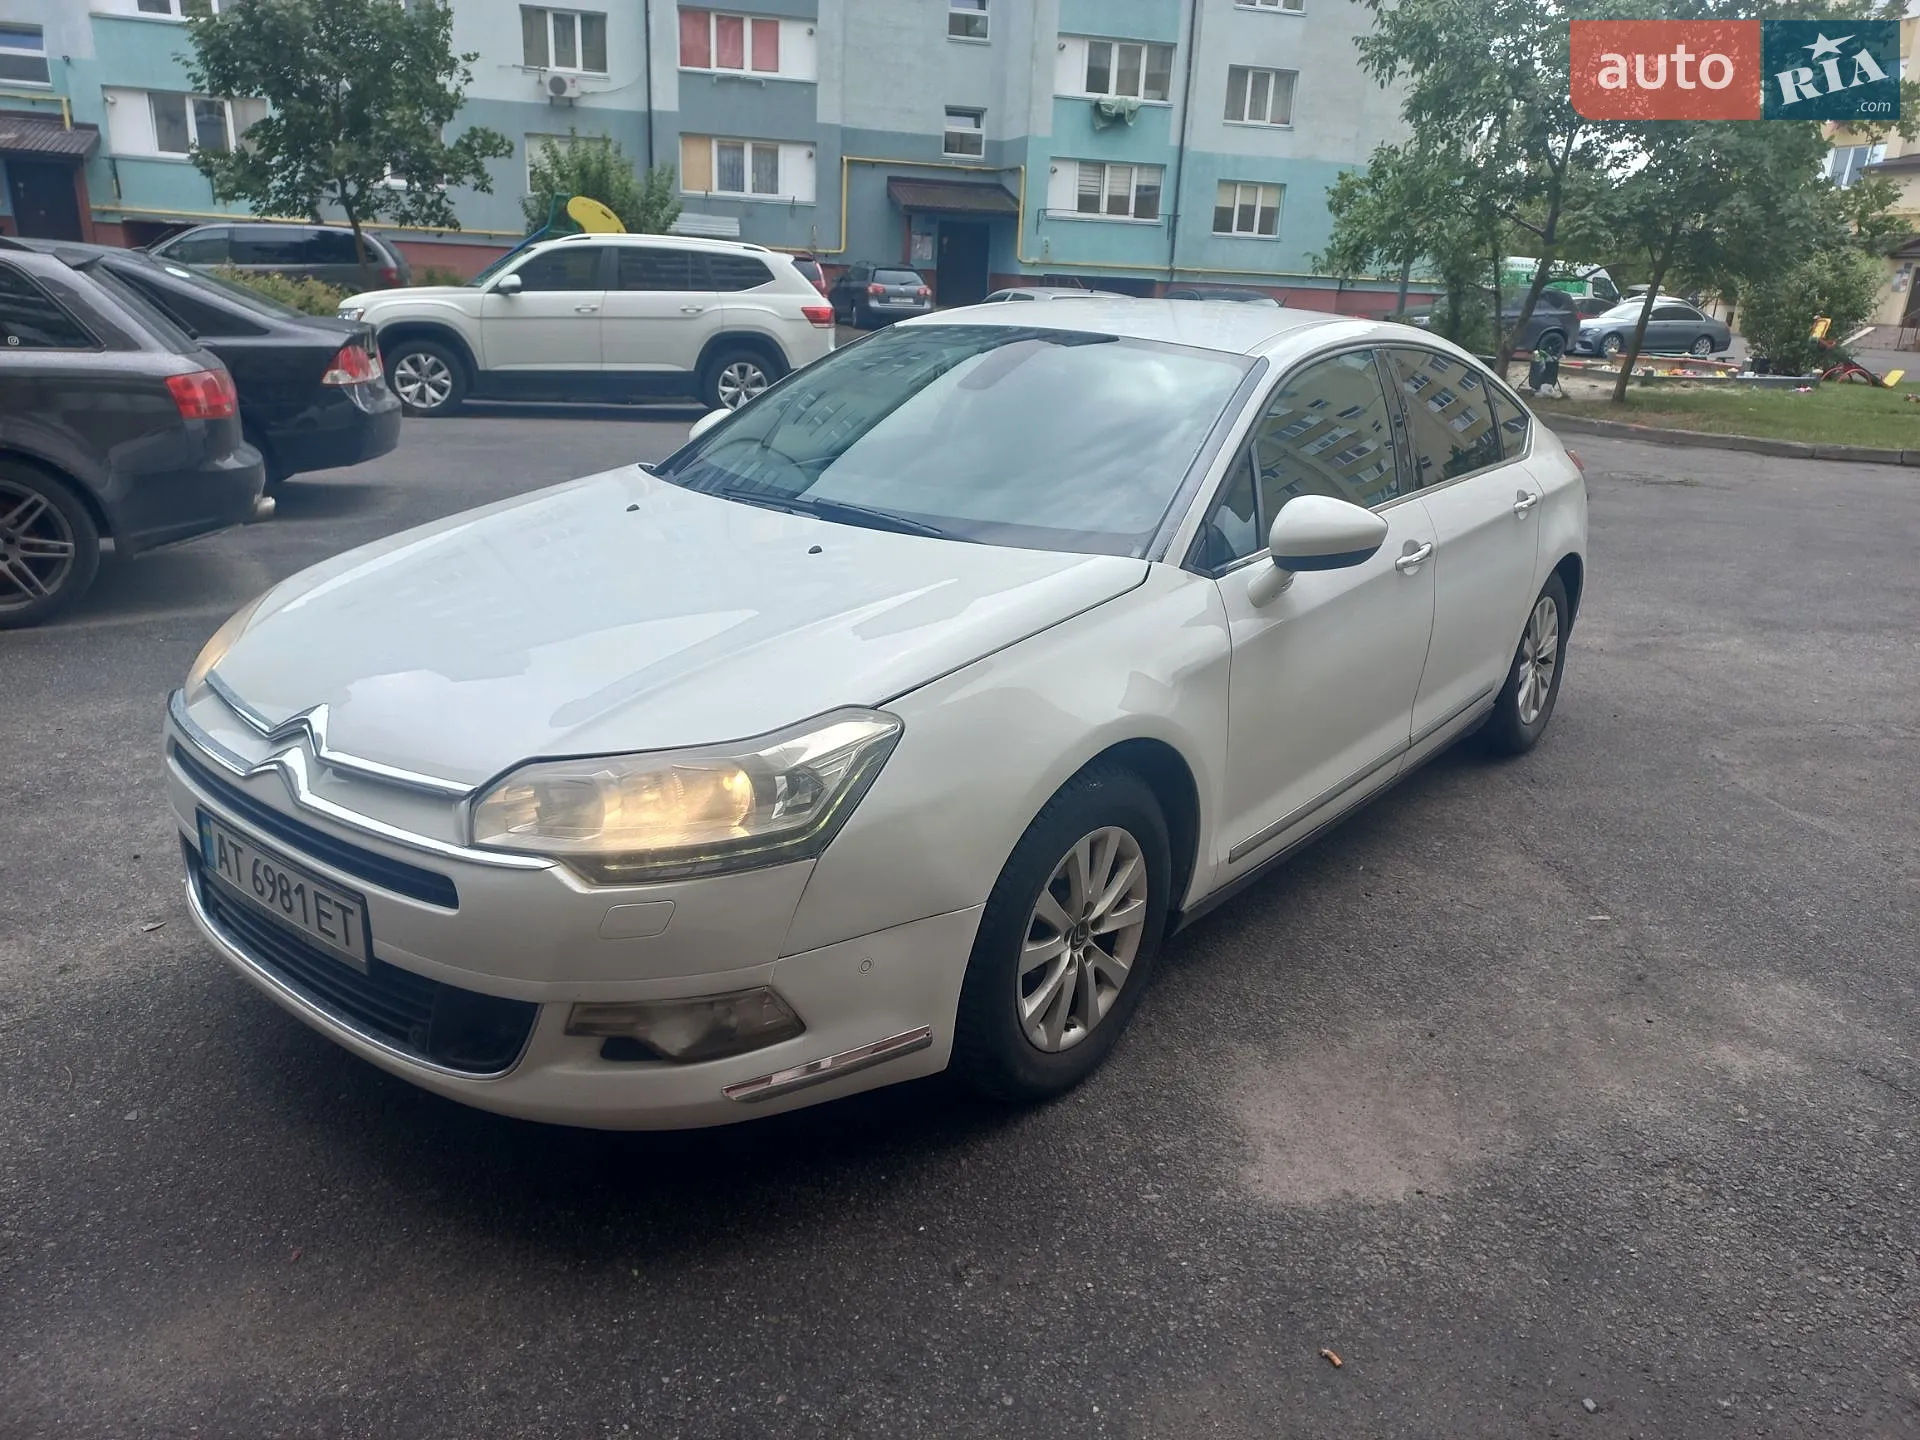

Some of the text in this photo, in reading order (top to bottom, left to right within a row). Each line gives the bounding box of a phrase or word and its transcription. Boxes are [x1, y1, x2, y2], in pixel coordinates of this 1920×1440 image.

[217, 832, 354, 946] AT 6981 ET
